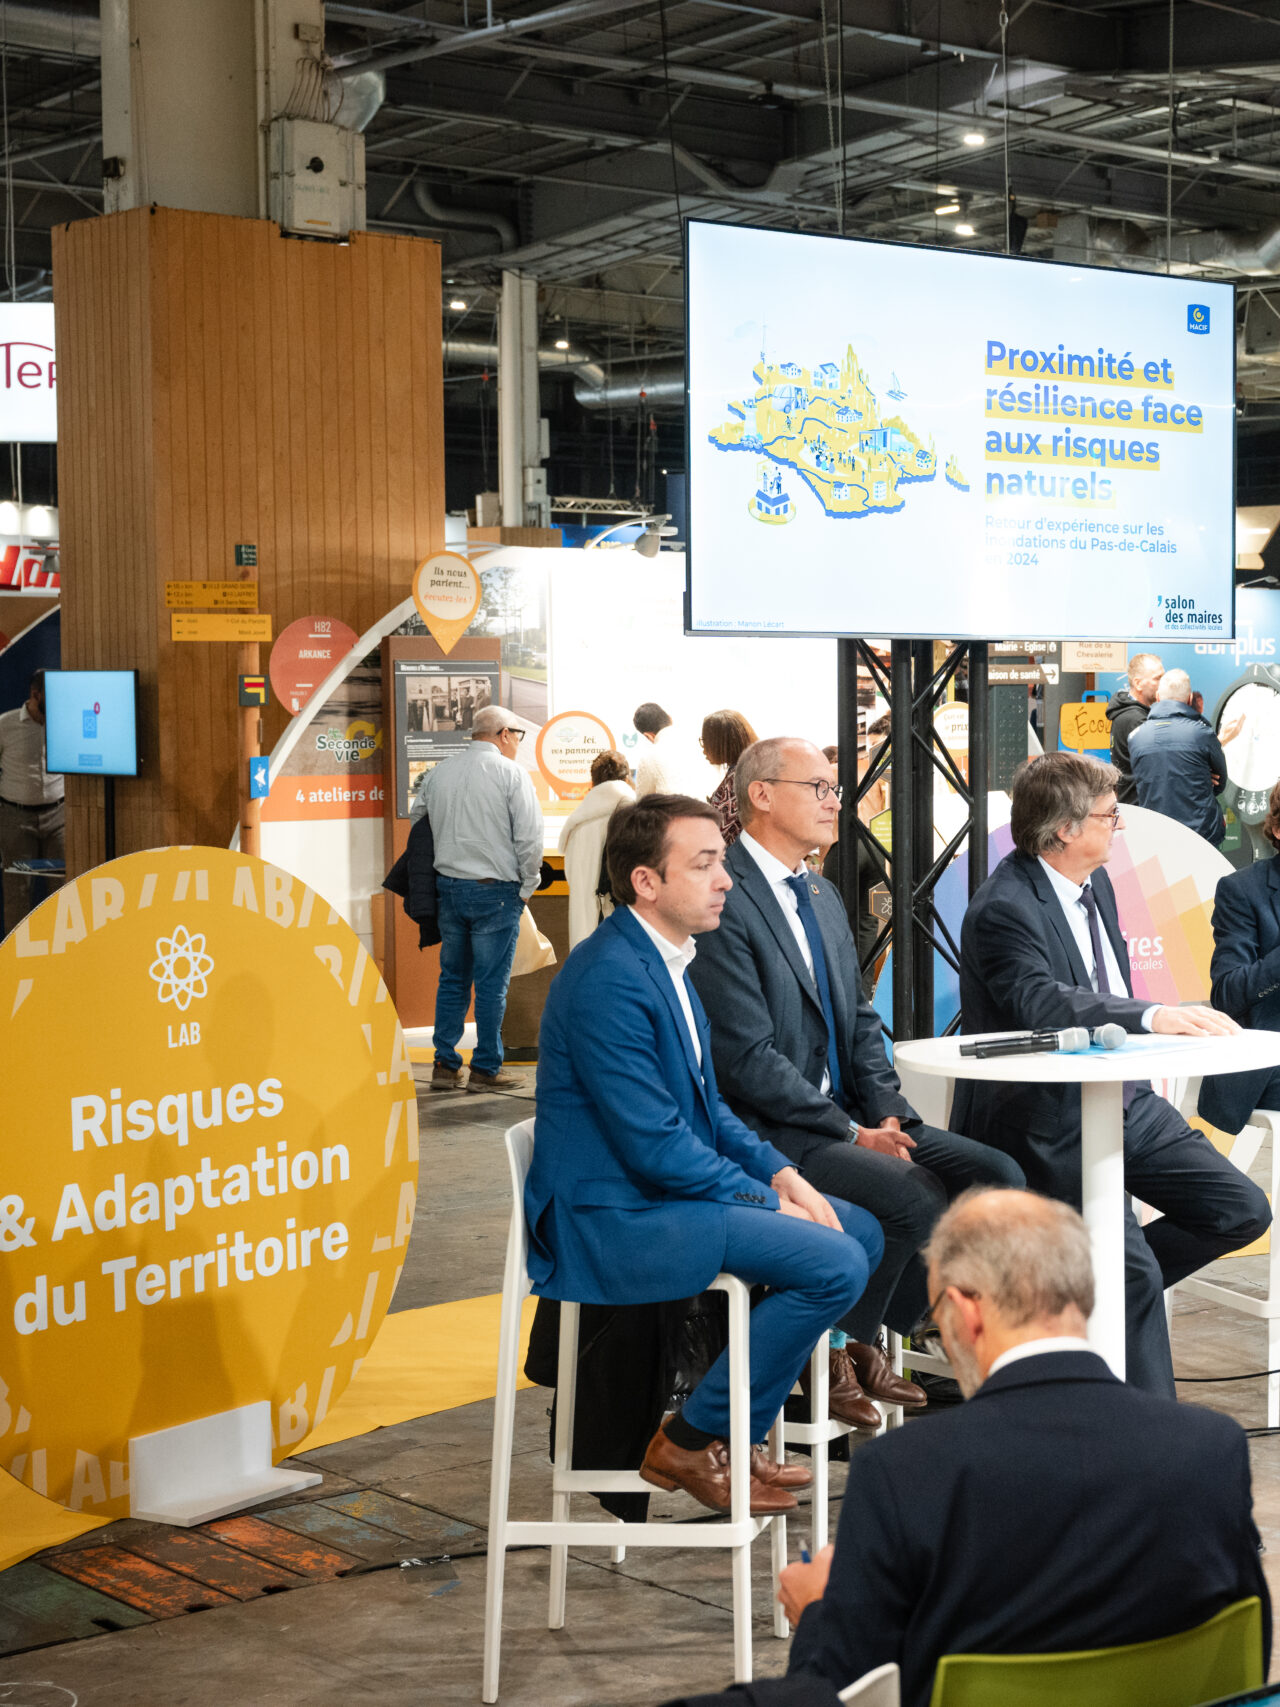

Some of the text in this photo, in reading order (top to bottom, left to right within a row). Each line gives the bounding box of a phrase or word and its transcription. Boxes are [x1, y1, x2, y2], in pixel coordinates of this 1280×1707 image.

[1189, 323, 1208, 331] MACIF
[987, 340, 1173, 384] Proximité et
[986, 382, 1203, 426] résilience face
[985, 426, 1160, 467] aux risques
[986, 470, 1113, 500] naturels
[985, 515, 1164, 536] Retour d'expérience sur les
[1070, 536, 1087, 550] du
[1090, 537, 1177, 554] Pas-de-Calais
[1006, 553, 1039, 566] 2024
[1165, 595, 1195, 609] salon
[1165, 609, 1223, 624] des maires
[994, 641, 1018, 652] Mairie
[988, 668, 1040, 680] aison de santé
[316, 735, 377, 751] Seconde
[295, 789, 305, 803] 4
[308, 786, 366, 802] ateliers
[167, 1022, 201, 1049] LAB
[70, 1077, 285, 1152] Risques
[0, 1139, 351, 1253] & Adaptation
[13, 1217, 350, 1336] du Territoire
